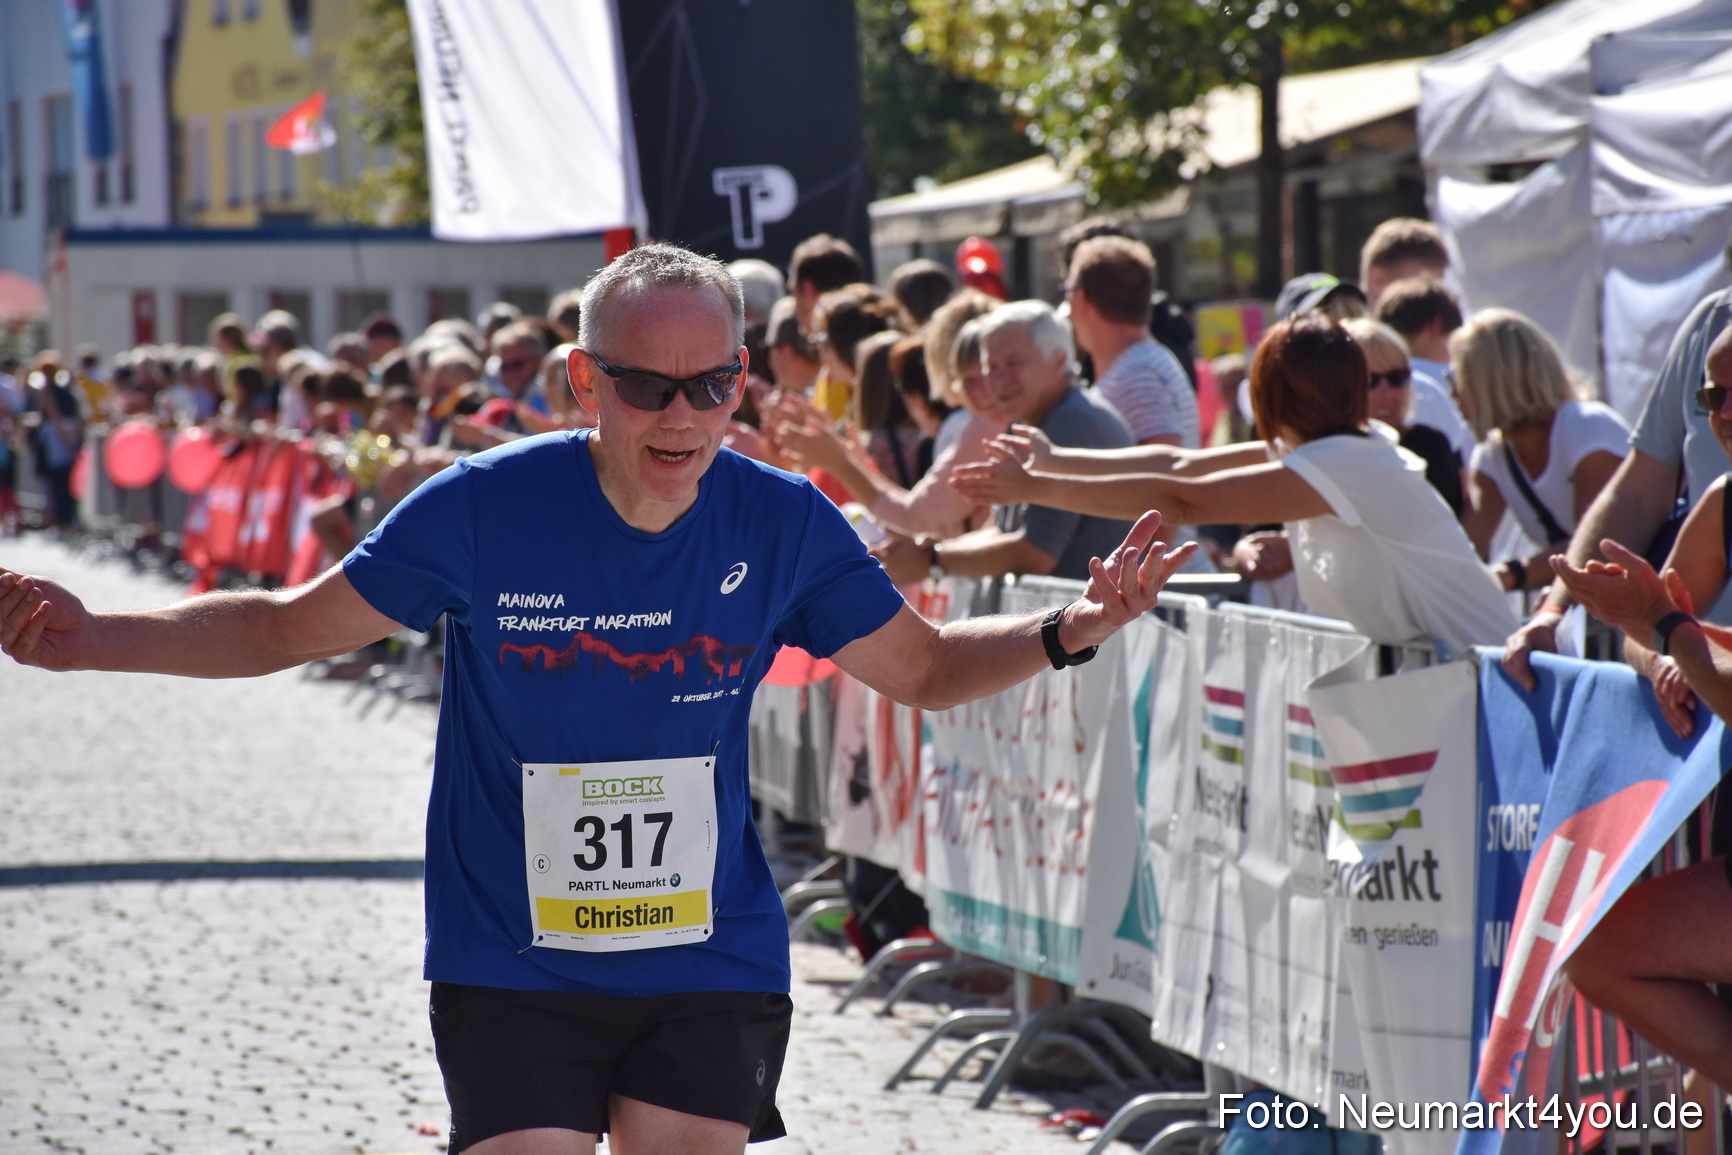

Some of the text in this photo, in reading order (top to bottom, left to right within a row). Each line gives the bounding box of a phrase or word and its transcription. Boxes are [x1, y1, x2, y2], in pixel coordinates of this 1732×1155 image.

[498, 592, 564, 609] MAINOVA
[497, 609, 672, 632] FRANKFURT MARATHON
[683, 692, 712, 703] OKTOBER
[582, 775, 665, 799] BOCK
[582, 795, 666, 807] inspired by smart concepts
[1487, 803, 1541, 852] STORE
[573, 811, 673, 872] 317
[537, 858, 545, 870] C
[568, 880, 610, 892] PARTL
[612, 877, 667, 891] Neumarkt
[575, 902, 674, 930] Christian
